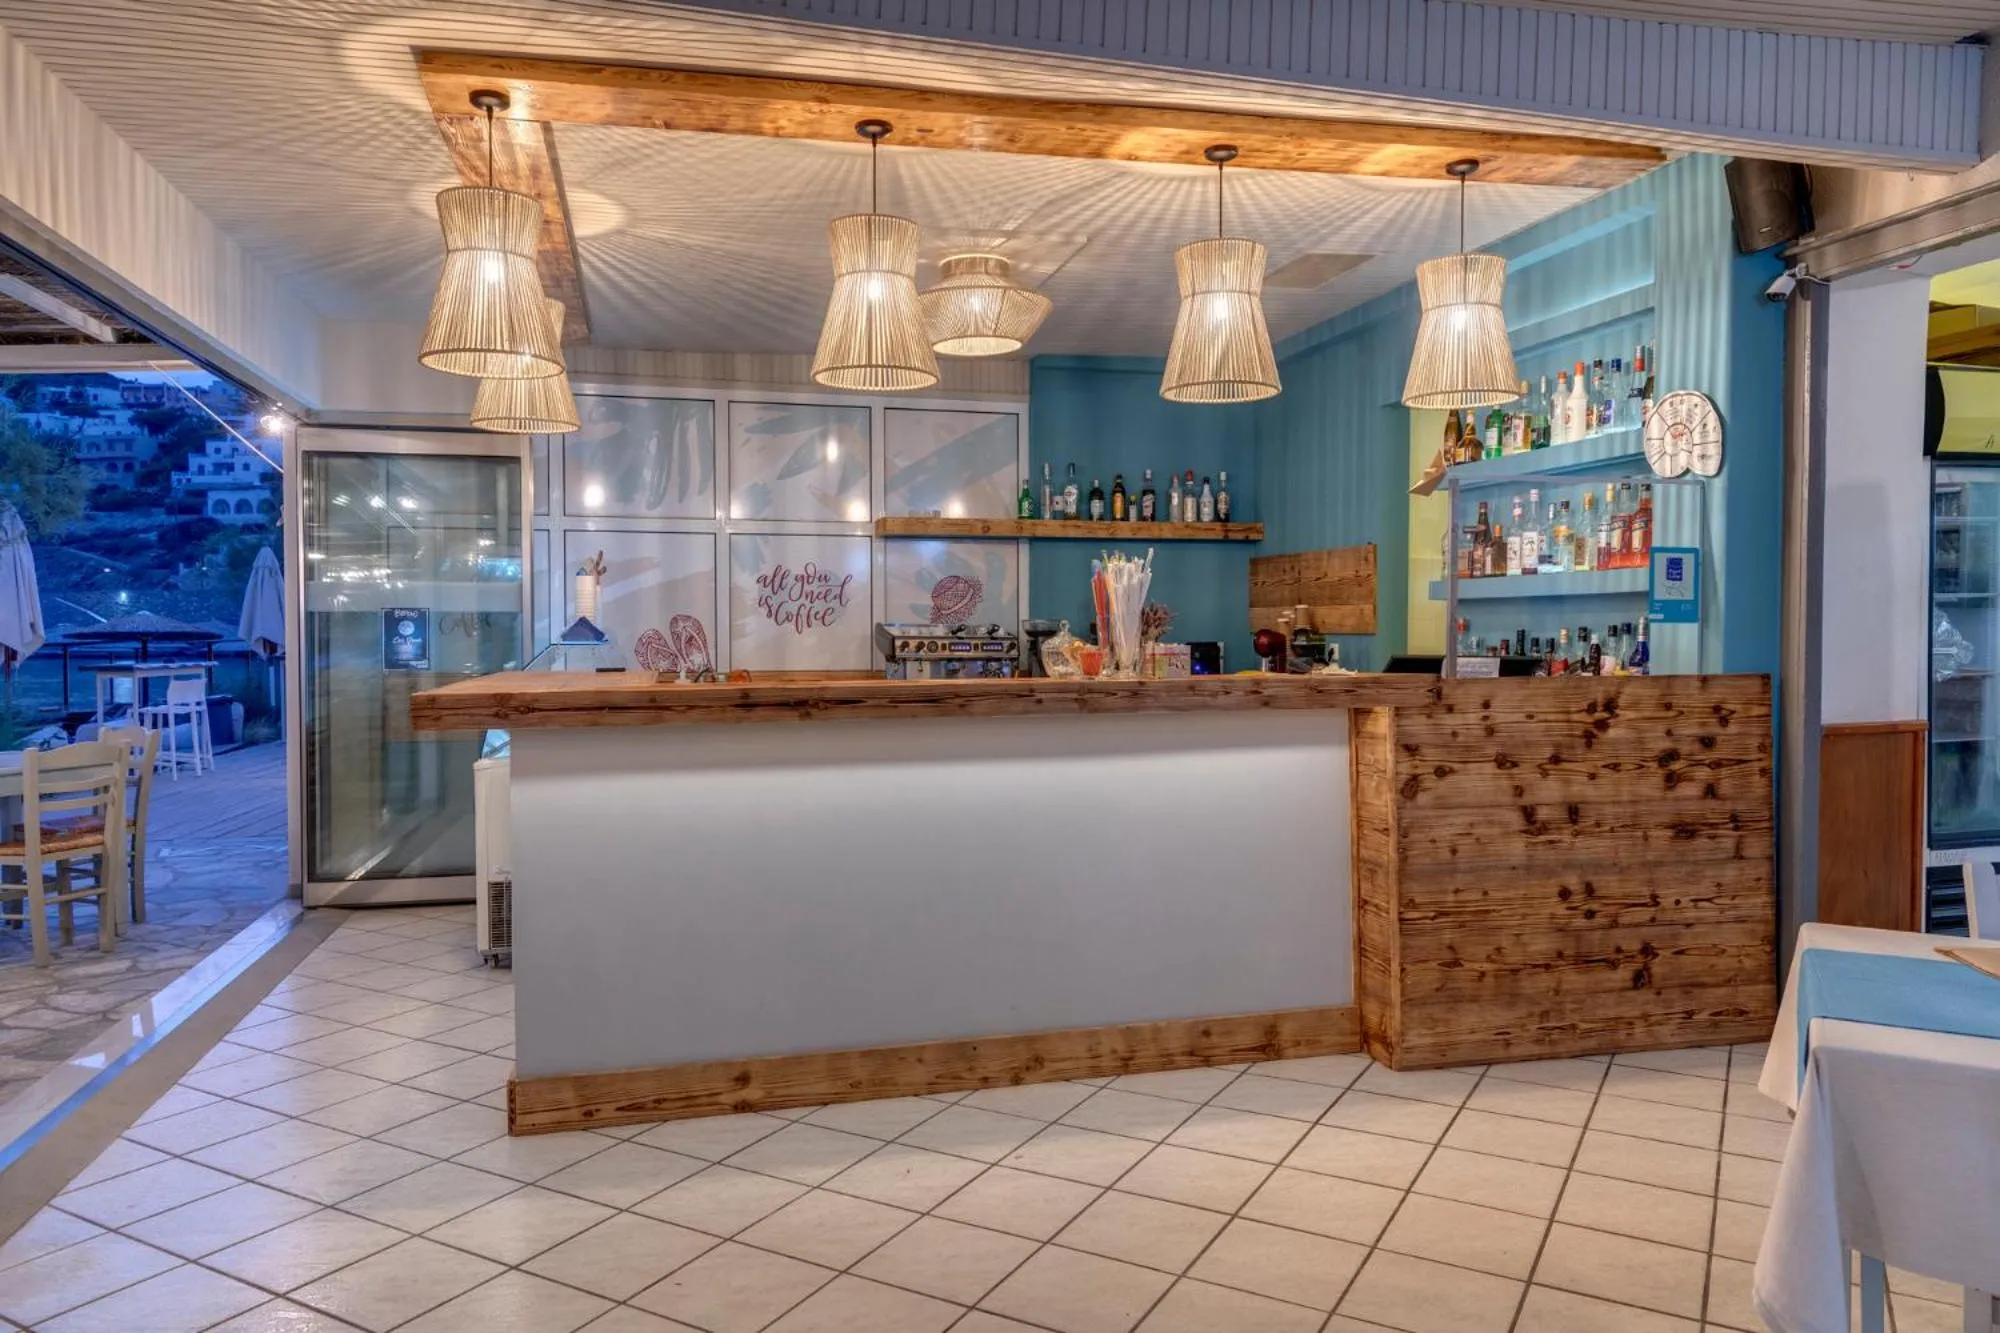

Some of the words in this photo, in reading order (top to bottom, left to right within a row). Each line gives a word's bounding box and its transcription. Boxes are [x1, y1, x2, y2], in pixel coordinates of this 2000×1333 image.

[756, 565, 790, 595] all
[789, 561, 831, 602] you
[804, 574, 853, 607] need
[758, 595, 774, 619] is
